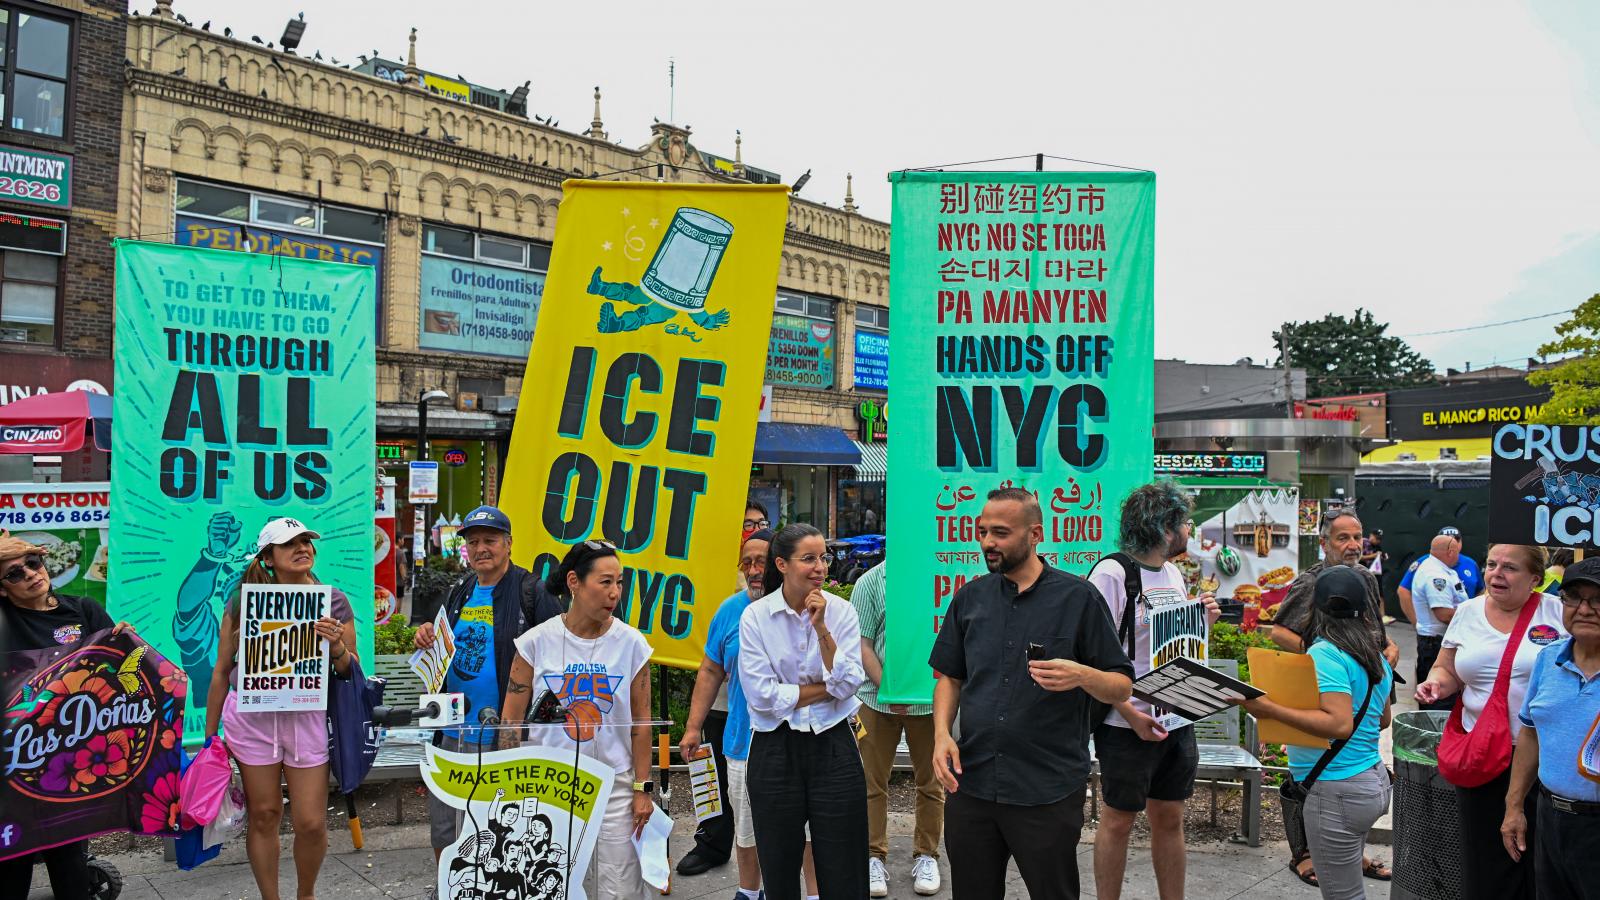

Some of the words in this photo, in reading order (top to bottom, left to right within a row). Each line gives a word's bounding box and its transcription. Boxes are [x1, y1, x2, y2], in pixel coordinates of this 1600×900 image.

[0, 177, 60, 201] 2626
[940, 182, 1106, 215] 别碰纽约市
[937, 222, 980, 252] NYC
[987, 222, 1017, 252] NO
[1022, 222, 1048, 252] SE
[1053, 223, 1107, 252] TOCA
[451, 268, 544, 297] Ortodontista
[938, 257, 1030, 283] 손대지
[1045, 257, 1108, 283] 마라
[163, 279, 188, 299] TO
[196, 283, 234, 304] GET
[241, 287, 265, 308] TO
[273, 290, 336, 313] THEM,
[431, 286, 472, 302] Frenillos
[475, 294, 496, 305] para
[498, 296, 531, 309] Adultos
[937, 290, 973, 323] PA
[983, 289, 1107, 323] MANYEN
[163, 303, 205, 326] YOU
[213, 309, 265, 332] HAVE
[271, 313, 295, 333] TO
[302, 316, 329, 335] GO
[475, 308, 524, 326] Invisalign
[163, 327, 333, 374] THROUGH
[936, 334, 1048, 376] HANDS
[1056, 334, 1113, 377] OFF
[766, 369, 822, 385] 8)458-9000
[161, 369, 332, 449] ALL
[557, 346, 727, 457] ICE
[1423, 412, 1437, 426] EL
[1439, 408, 1486, 424] MANGO
[1488, 406, 1521, 422] RICO
[3, 426, 62, 443] CINZANO
[936, 383, 1110, 473] NYC
[159, 447, 234, 502] OF
[253, 451, 332, 505] US
[1218, 455, 1227, 468] Y
[0, 493, 16, 509] A
[22, 492, 110, 508] CORON
[542, 452, 708, 561] OUT
[936, 485, 976, 511] عن
[0, 512, 25, 525] 718
[31, 511, 65, 524] 696
[1053, 515, 1102, 543] LOXO
[936, 551, 980, 565] আমার
[246, 591, 325, 620] EVERYONE
[246, 620, 259, 636] IS
[1152, 602, 1206, 655] IMMIGRANTS
[245, 621, 323, 675] WELCOME
[1157, 638, 1186, 667] MAKE
[294, 658, 322, 675] HERE
[564, 664, 607, 673] ABOLISH
[243, 676, 295, 691] EXCEPT
[299, 676, 322, 690] ICE
[556, 673, 613, 702] ICE
[3, 723, 62, 776] Las
[59, 693, 156, 747] Doñas
[448, 769, 500, 785] MAKE
[504, 765, 540, 781] THE
[544, 767, 595, 796] ROAD
[515, 783, 549, 794] NEW
[553, 787, 590, 811] YORK
